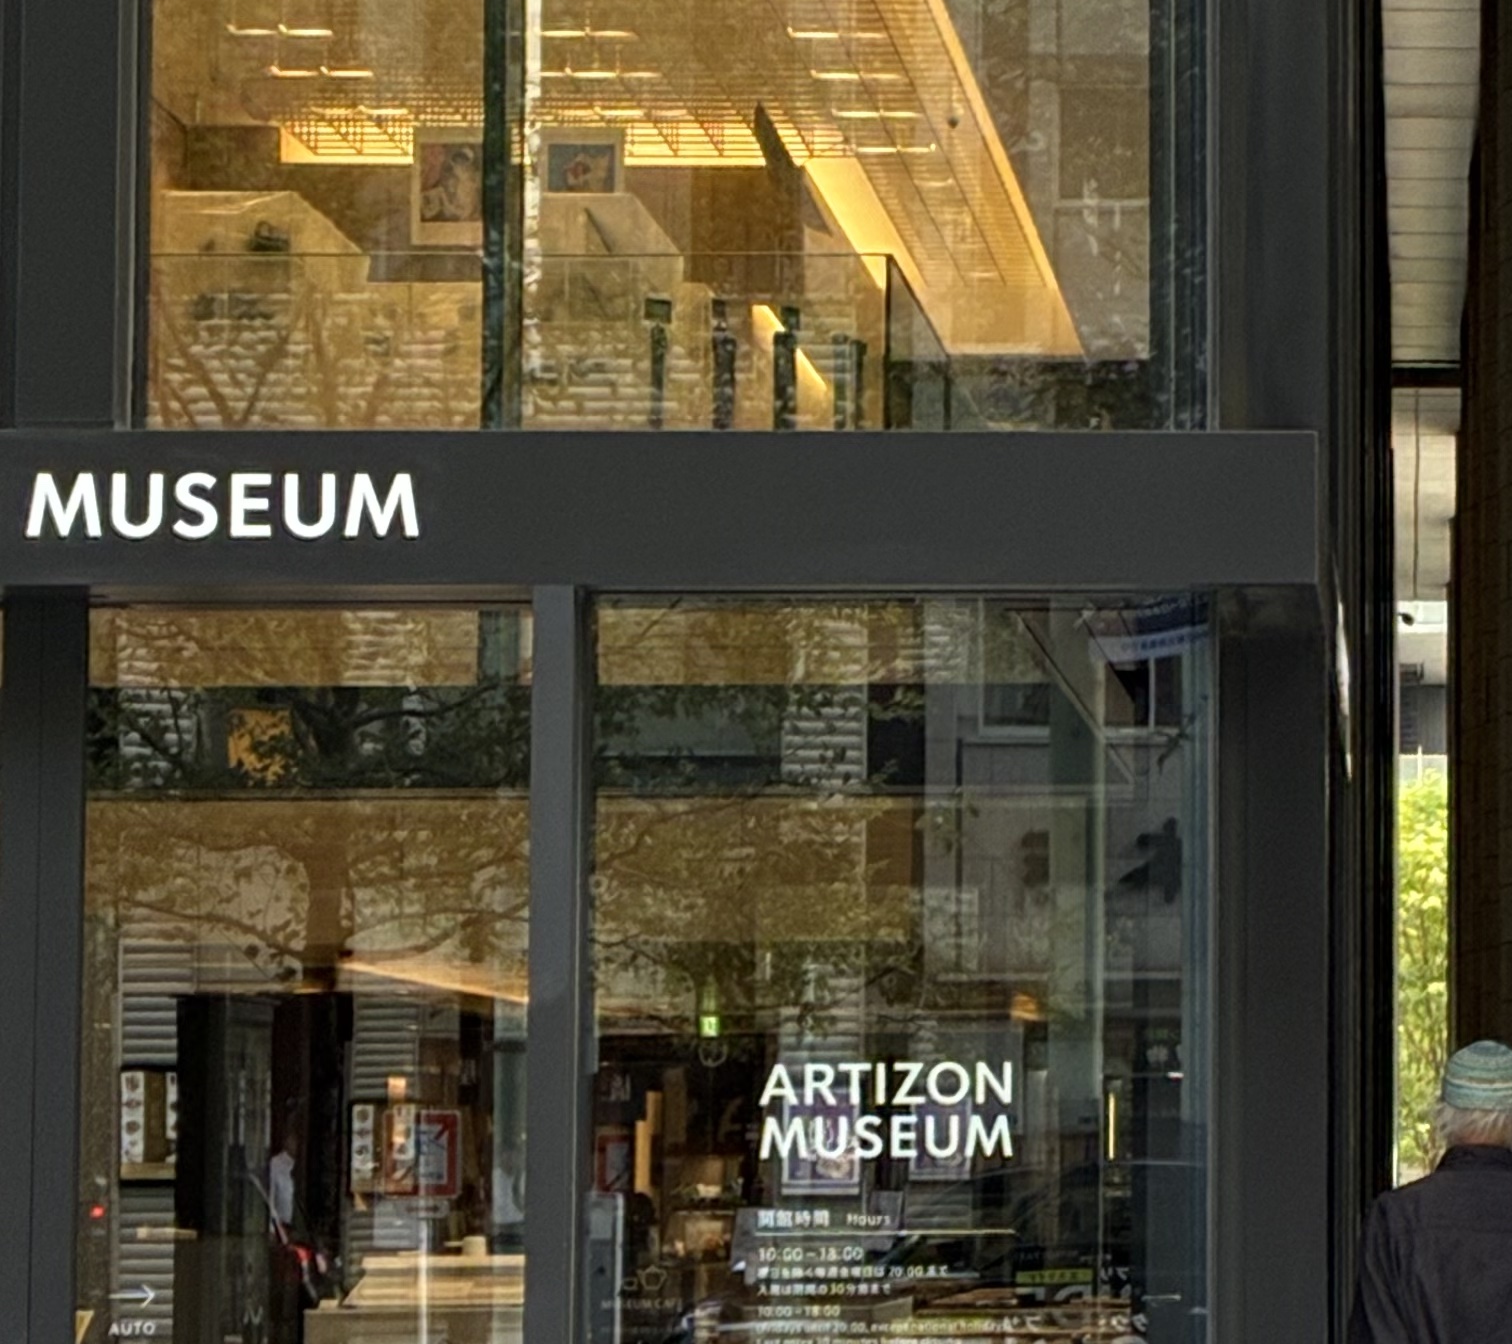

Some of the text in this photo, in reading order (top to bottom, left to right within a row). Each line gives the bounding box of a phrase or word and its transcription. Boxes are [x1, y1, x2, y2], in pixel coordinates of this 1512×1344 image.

[25, 471, 420, 540] MUSEUM
[758, 1060, 1012, 1106] ARTIZON
[759, 1114, 1013, 1159] MUSEUM
[757, 1209, 891, 1228] 開館時間 Hours
[107, 1321, 156, 1336] AUTO
